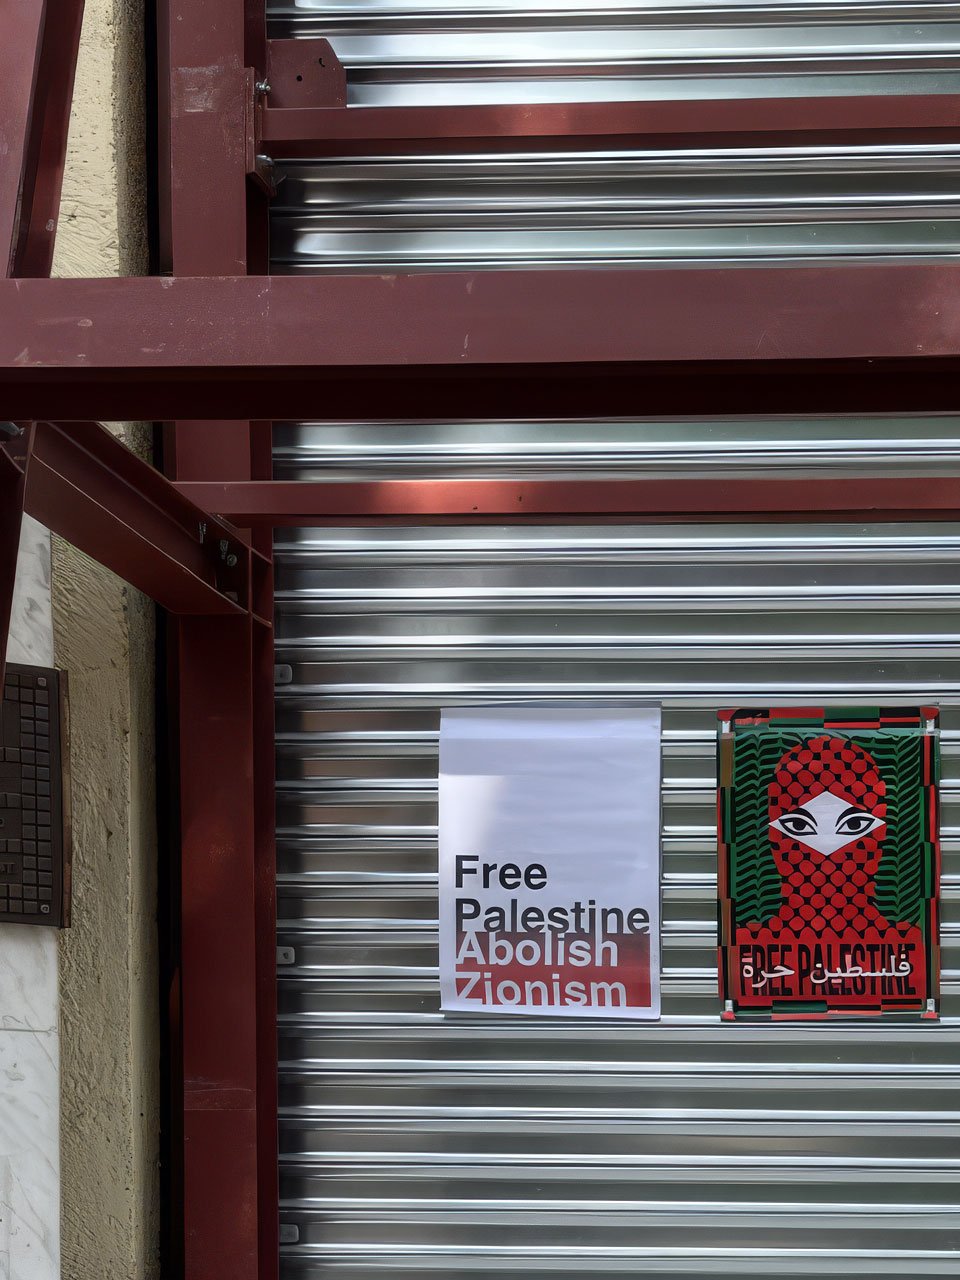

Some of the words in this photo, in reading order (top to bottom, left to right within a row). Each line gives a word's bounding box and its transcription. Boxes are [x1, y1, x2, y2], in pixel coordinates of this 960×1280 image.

[456, 855, 547, 890] Free
[456, 898, 650, 934] Palestine
[456, 931, 618, 967] Abolish
[740, 944, 793, 996] FREE
[798, 943, 916, 996] PALESTINE
[742, 957, 796, 988] حرة
[810, 951, 912, 984] فلسطين
[456, 971, 627, 1007] Zionism
